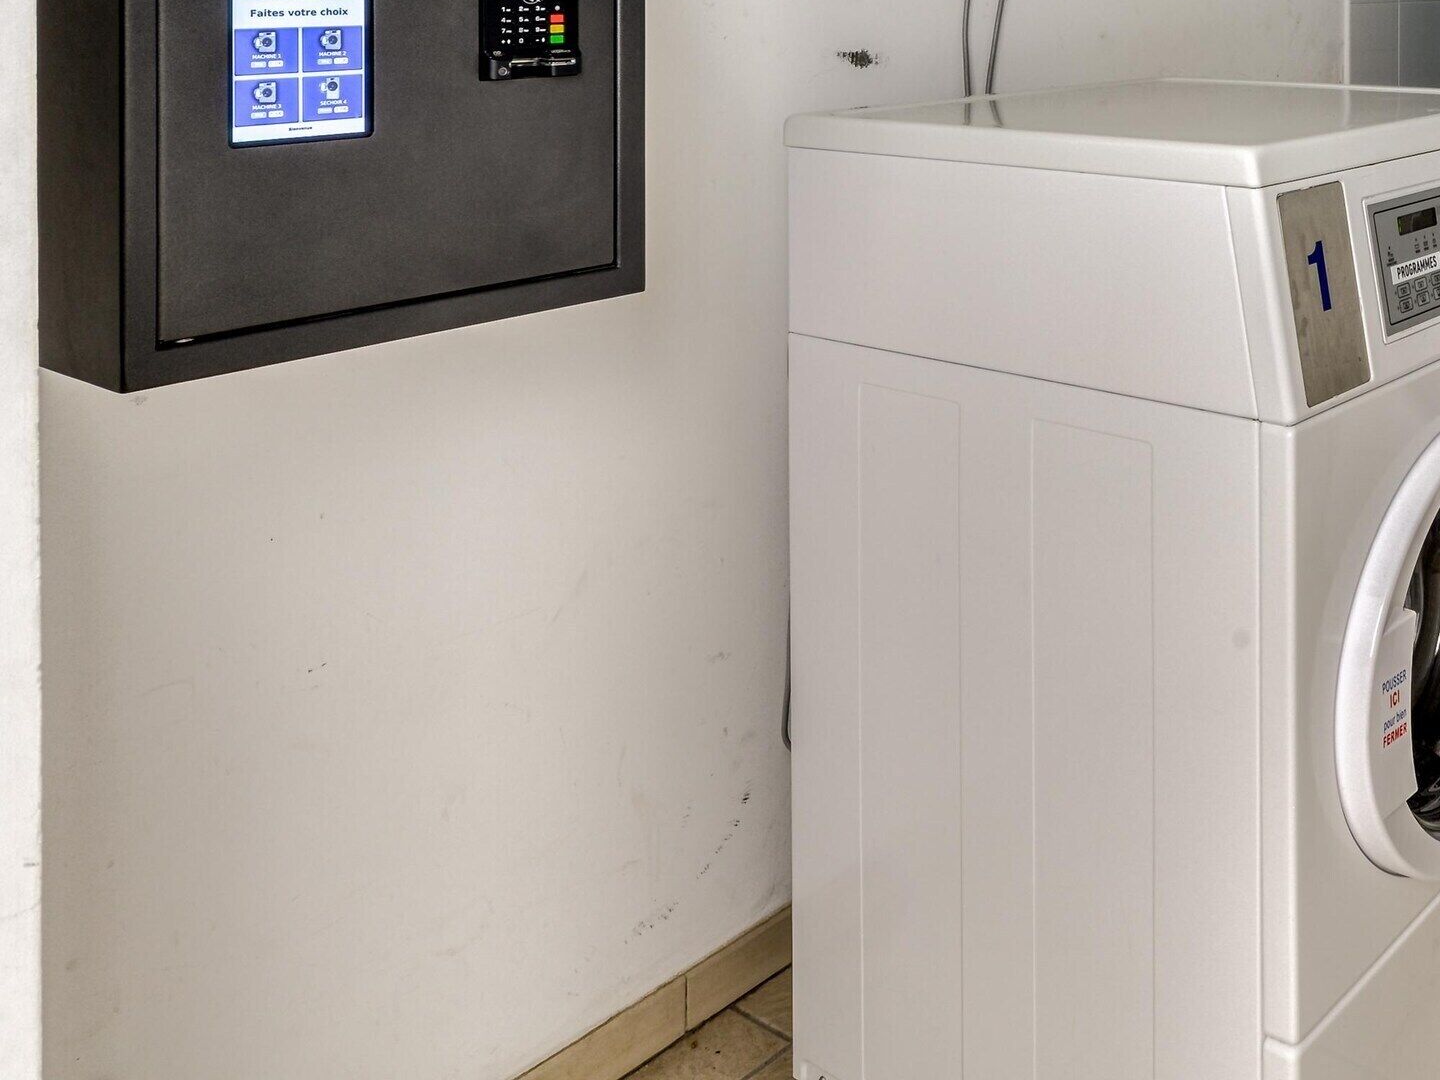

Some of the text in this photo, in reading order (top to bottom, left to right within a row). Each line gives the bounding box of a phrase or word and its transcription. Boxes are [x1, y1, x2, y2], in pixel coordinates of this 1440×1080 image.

[250, 9, 284, 17] Faites
[320, 8, 348, 16] choix
[1307, 240, 1332, 312] 1
[1397, 255, 1437, 280] PROGRAMMES
[1382, 669, 1407, 694] POUSSER
[1390, 690, 1400, 708] ICI
[1383, 709, 1407, 733] pour bien
[1383, 722, 1407, 748] FERMER
